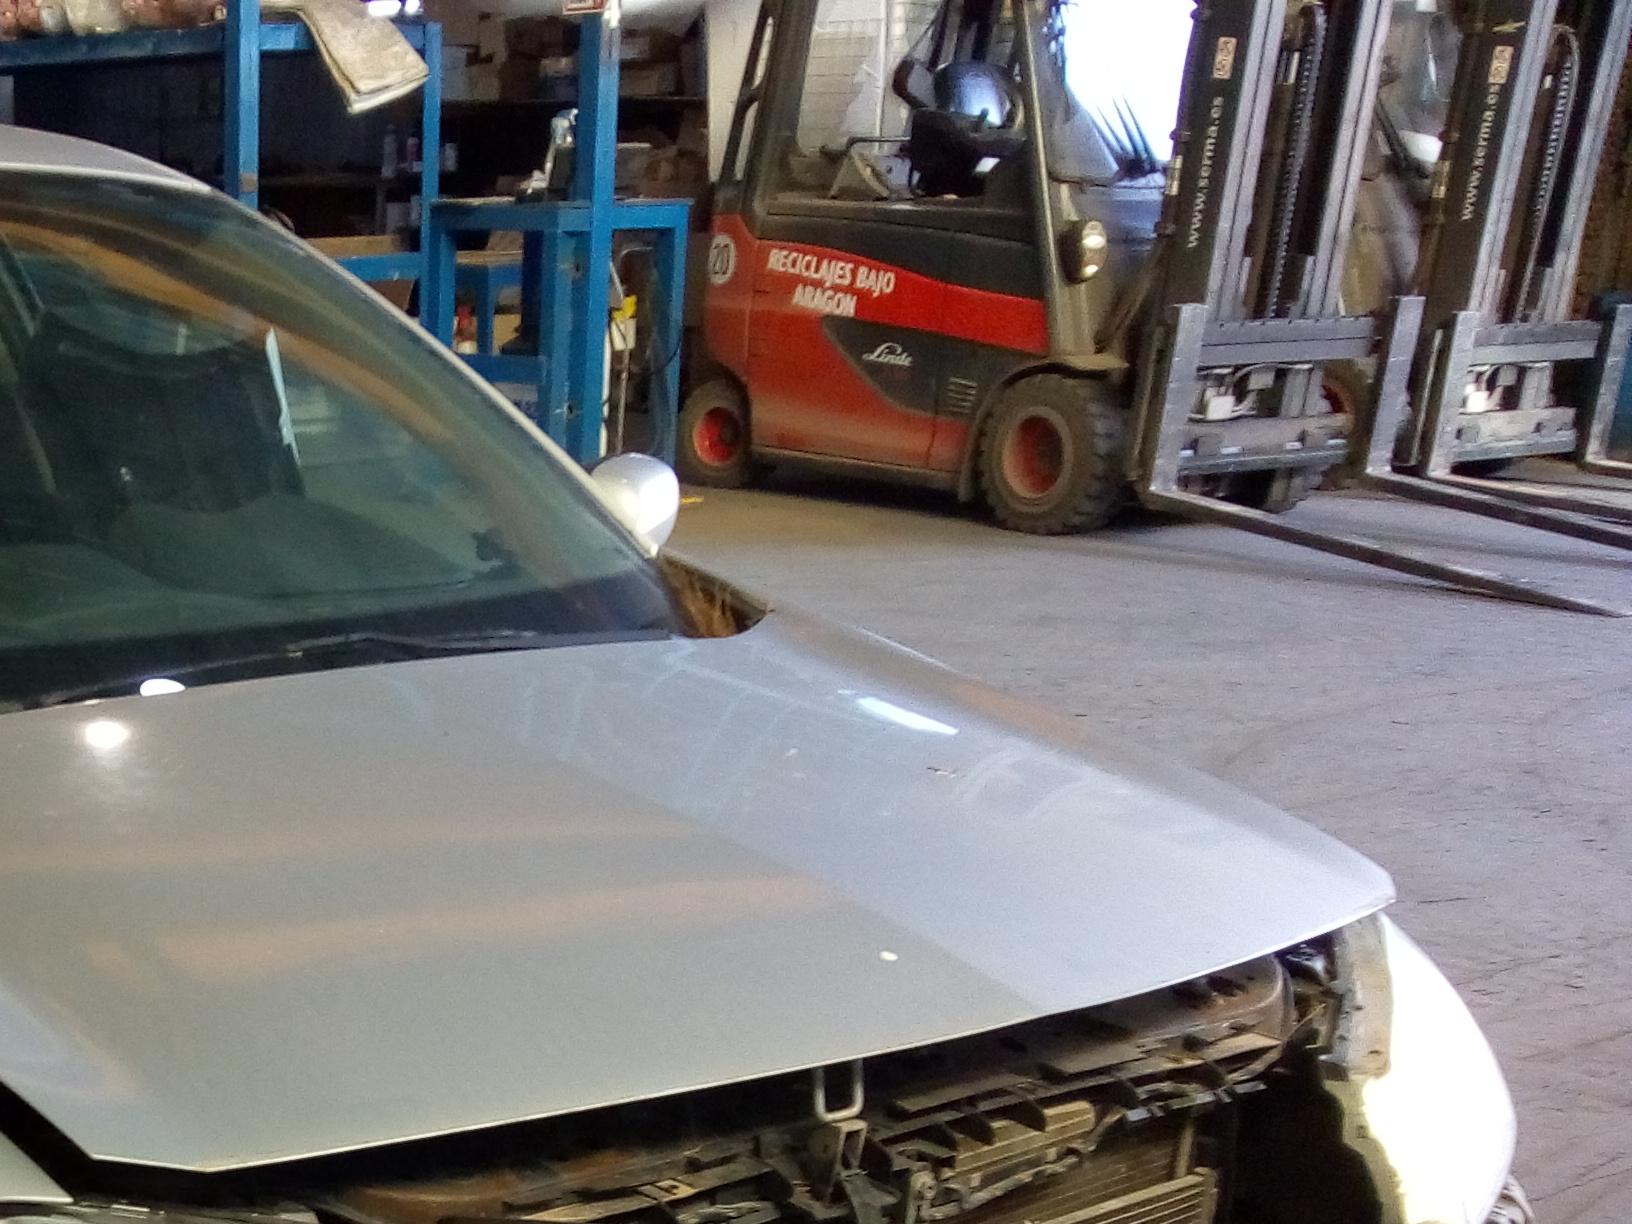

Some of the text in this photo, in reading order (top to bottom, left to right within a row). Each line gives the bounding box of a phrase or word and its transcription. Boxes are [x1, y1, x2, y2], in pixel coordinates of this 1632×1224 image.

[768, 249, 896, 297] RECICLAJES BAJO
[792, 285, 856, 317] ARAGON
[862, 341, 913, 367] Linde
